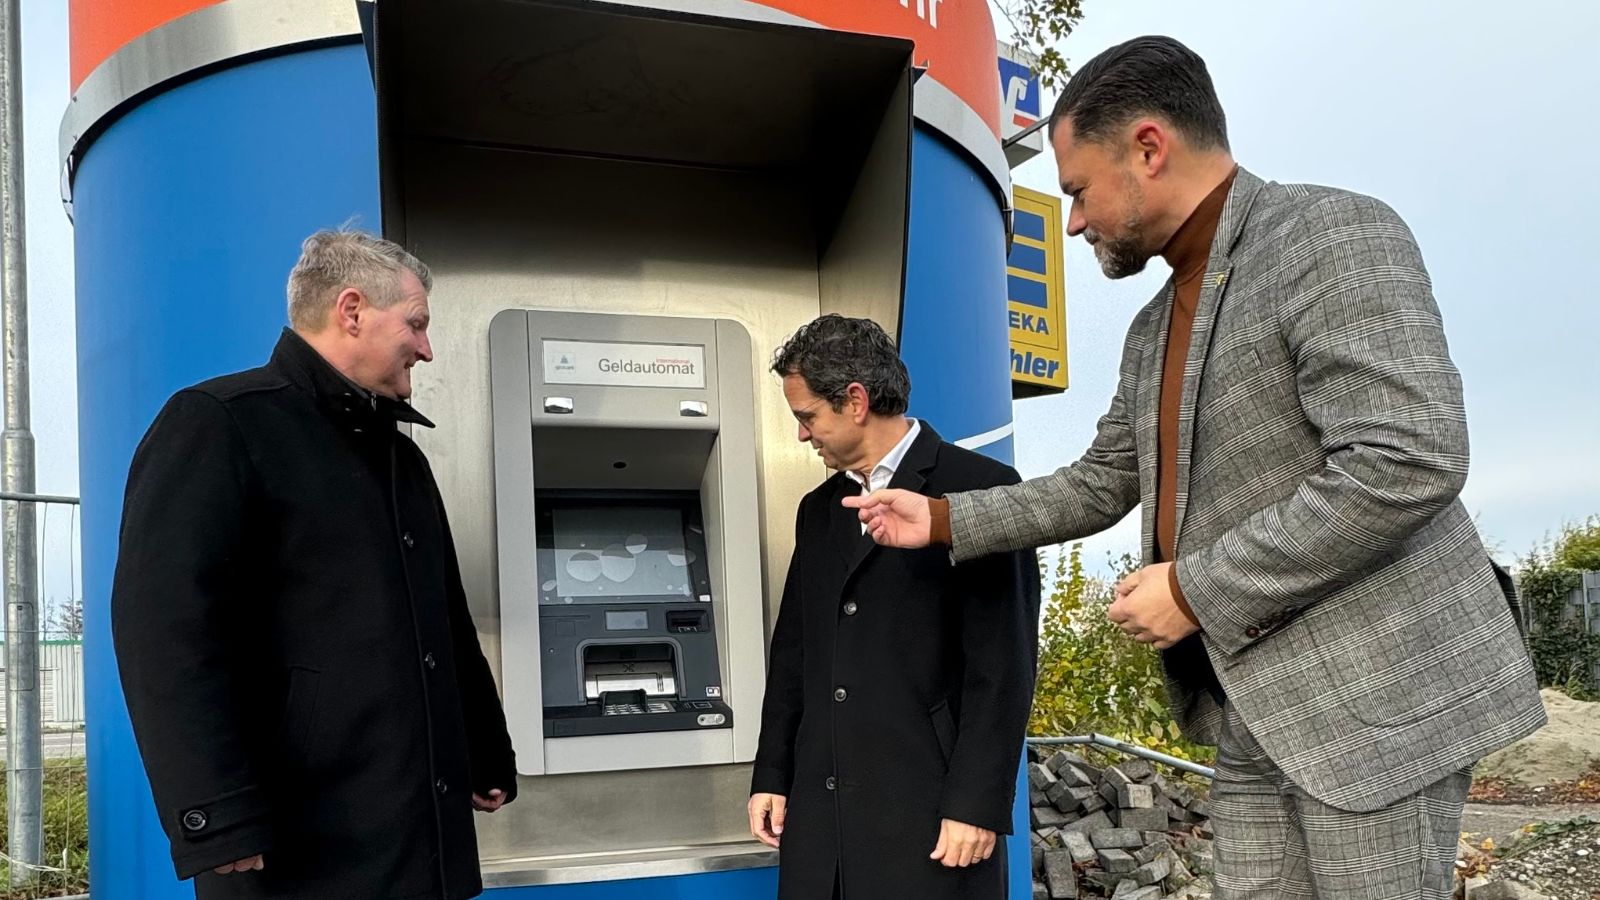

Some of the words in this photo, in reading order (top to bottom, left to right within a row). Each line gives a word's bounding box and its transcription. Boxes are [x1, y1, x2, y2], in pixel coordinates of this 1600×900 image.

[1008, 310, 1049, 335] EKA
[598, 358, 695, 375] Geldautomat
[1010, 348, 1059, 379] hler
